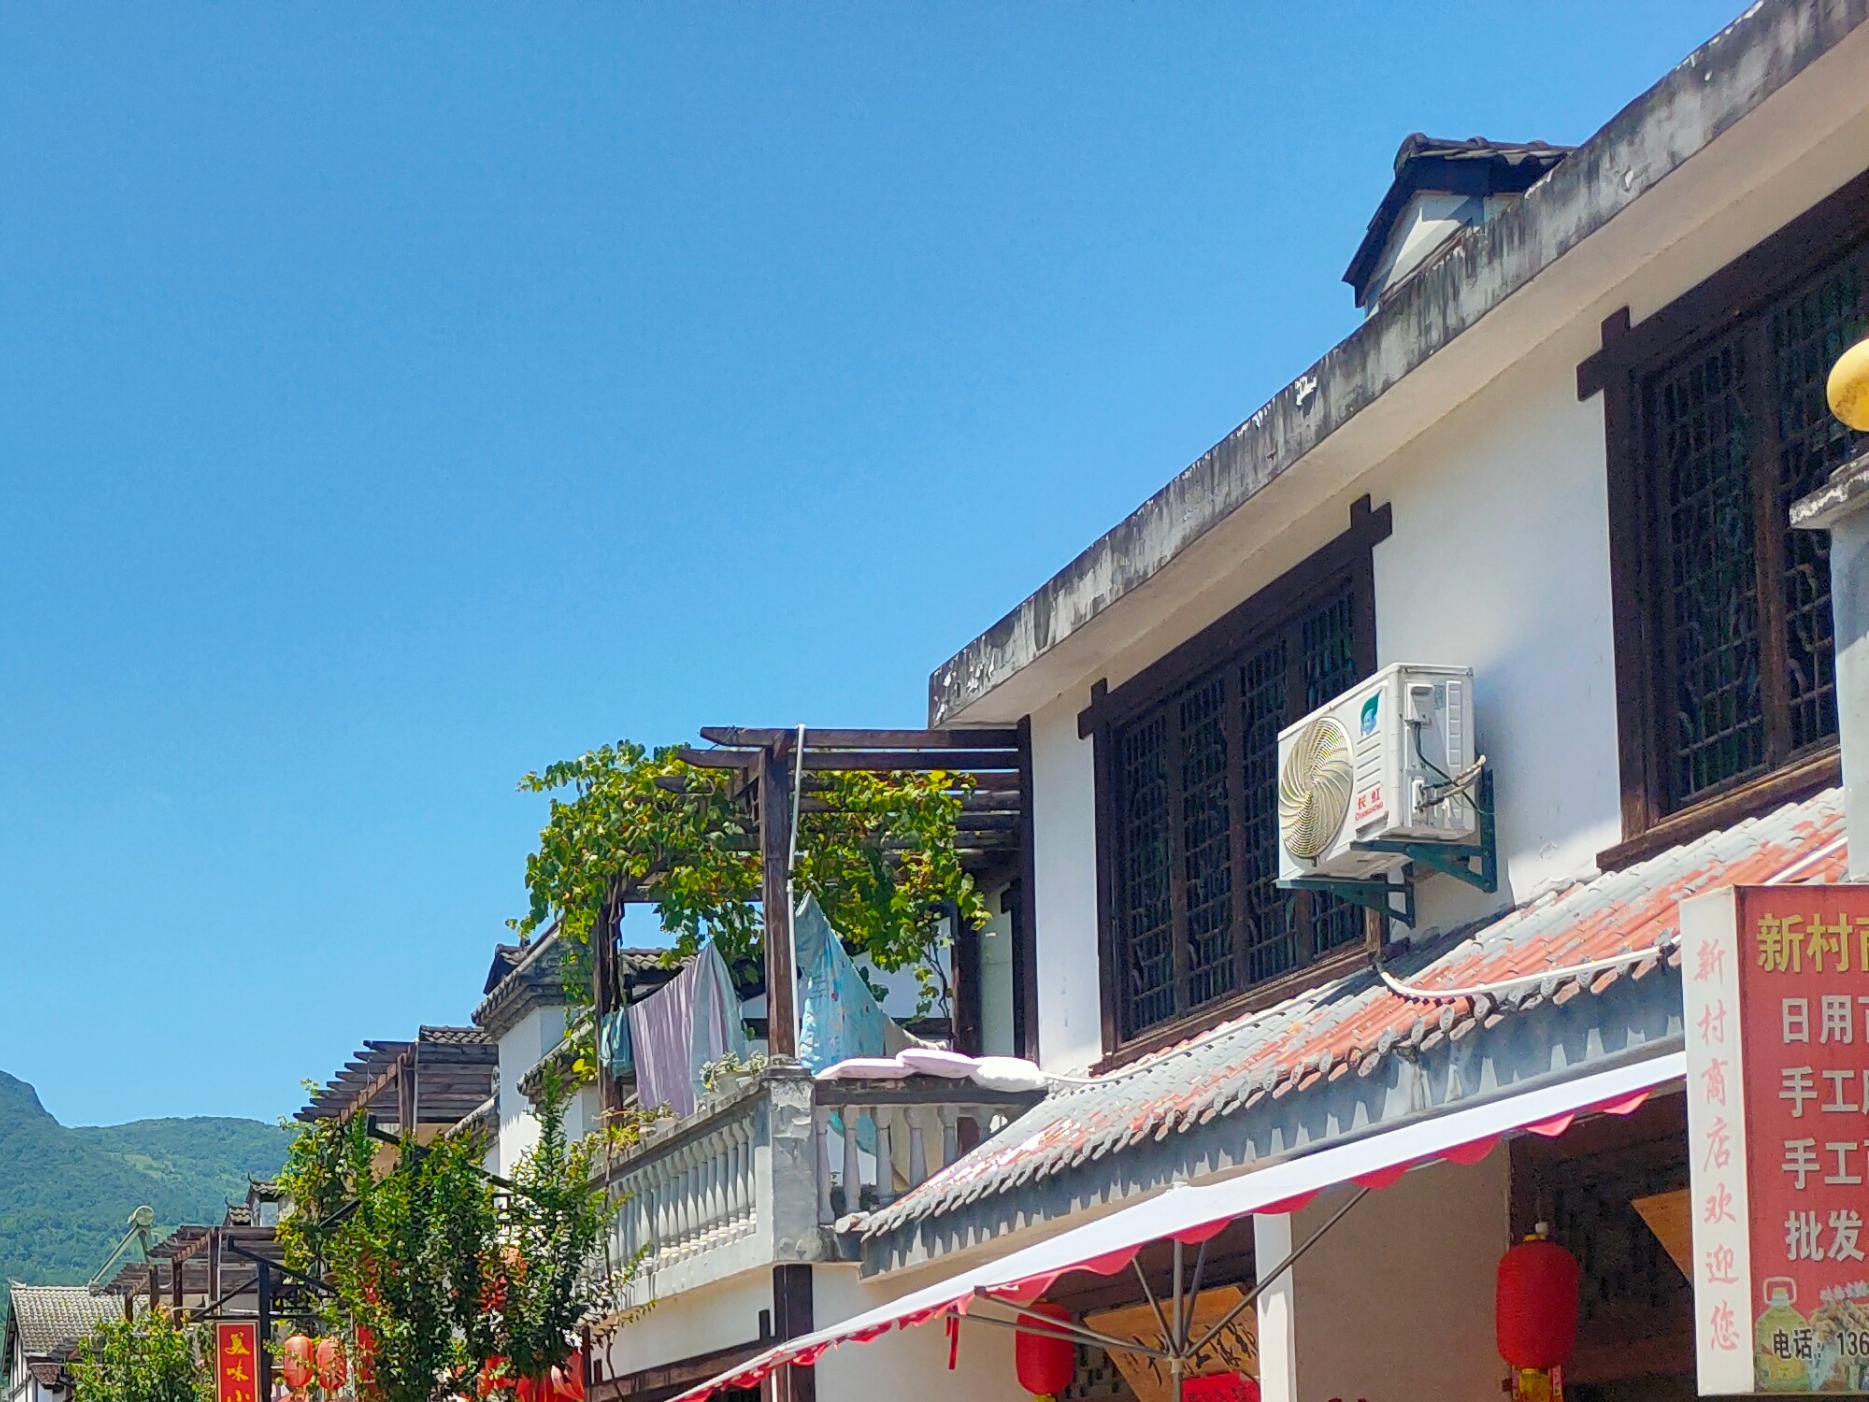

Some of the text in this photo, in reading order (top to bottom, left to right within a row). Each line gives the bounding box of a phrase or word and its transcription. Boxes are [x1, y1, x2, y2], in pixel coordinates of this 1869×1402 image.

[1358, 787, 1380, 809] 长虹
[1756, 912, 1869, 973] 新村
[1693, 939, 1740, 1351] 新村商店欢迎您
[1781, 1137, 1869, 1190] 手工
[1784, 1209, 1865, 1262] 批发
